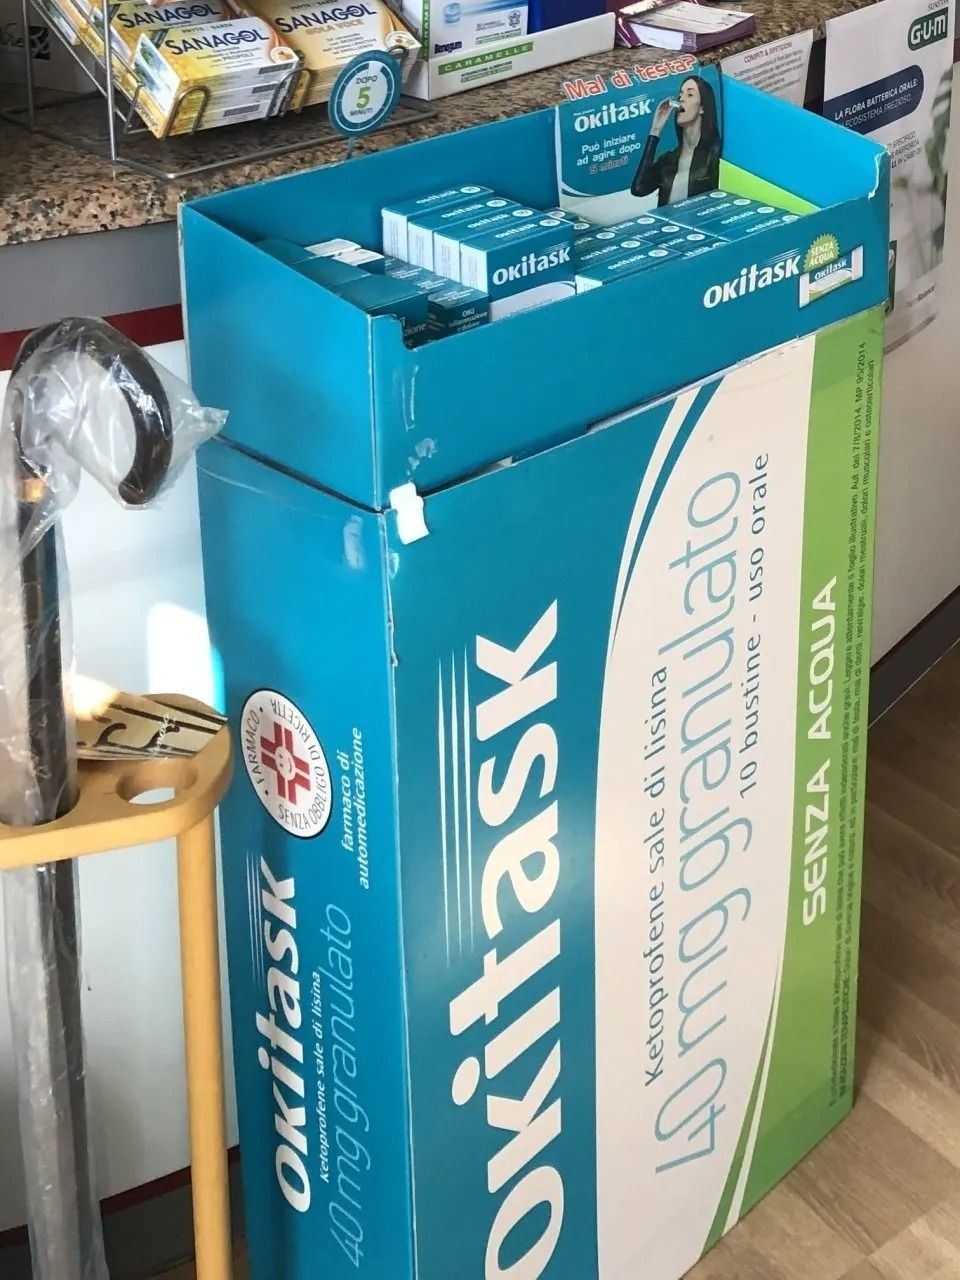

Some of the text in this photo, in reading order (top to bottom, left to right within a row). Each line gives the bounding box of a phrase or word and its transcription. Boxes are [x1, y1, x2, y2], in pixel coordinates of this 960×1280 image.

[117, 4, 222, 28] SANAGOL
[165, 28, 270, 55] SANAGOL
[444, 44, 530, 72] CARAMELLE
[355, 75, 378, 85] DOPO
[356, 86, 371, 110] 5
[563, 54, 697, 100] Mal di testa?
[350, 107, 374, 117] MINUTI
[574, 98, 652, 133] okitask
[835, 87, 898, 120] LA FLORA BATTERICA
[576, 141, 641, 167] ad agire dopo
[582, 132, 637, 154] Può iniziare
[492, 245, 571, 286] okitask
[809, 251, 835, 267] ACQUA
[810, 241, 835, 256] SENZA
[814, 258, 848, 282] okitask
[703, 255, 801, 309] okitask
[847, 342, 867, 572] foglio del MP 95/2014
[738, 453, 771, 797] 10 bustine uso orale
[656, 471, 753, 891] granulato
[245, 709, 266, 785] FARMACO
[269, 698, 328, 830] SENZA OBBLIGO DI RICETTA
[802, 576, 838, 927] SENZA ACQUA
[337, 750, 355, 852] farmaco di
[350, 726, 370, 890] automedicazione
[642, 666, 670, 1085] Ketoprofene sale di lisina
[449, 599, 564, 1280] okitask
[256, 855, 312, 1214] okitask
[317, 905, 370, 1134] granulato
[309, 971, 331, 1183] Ketoprofene sale di lisina
